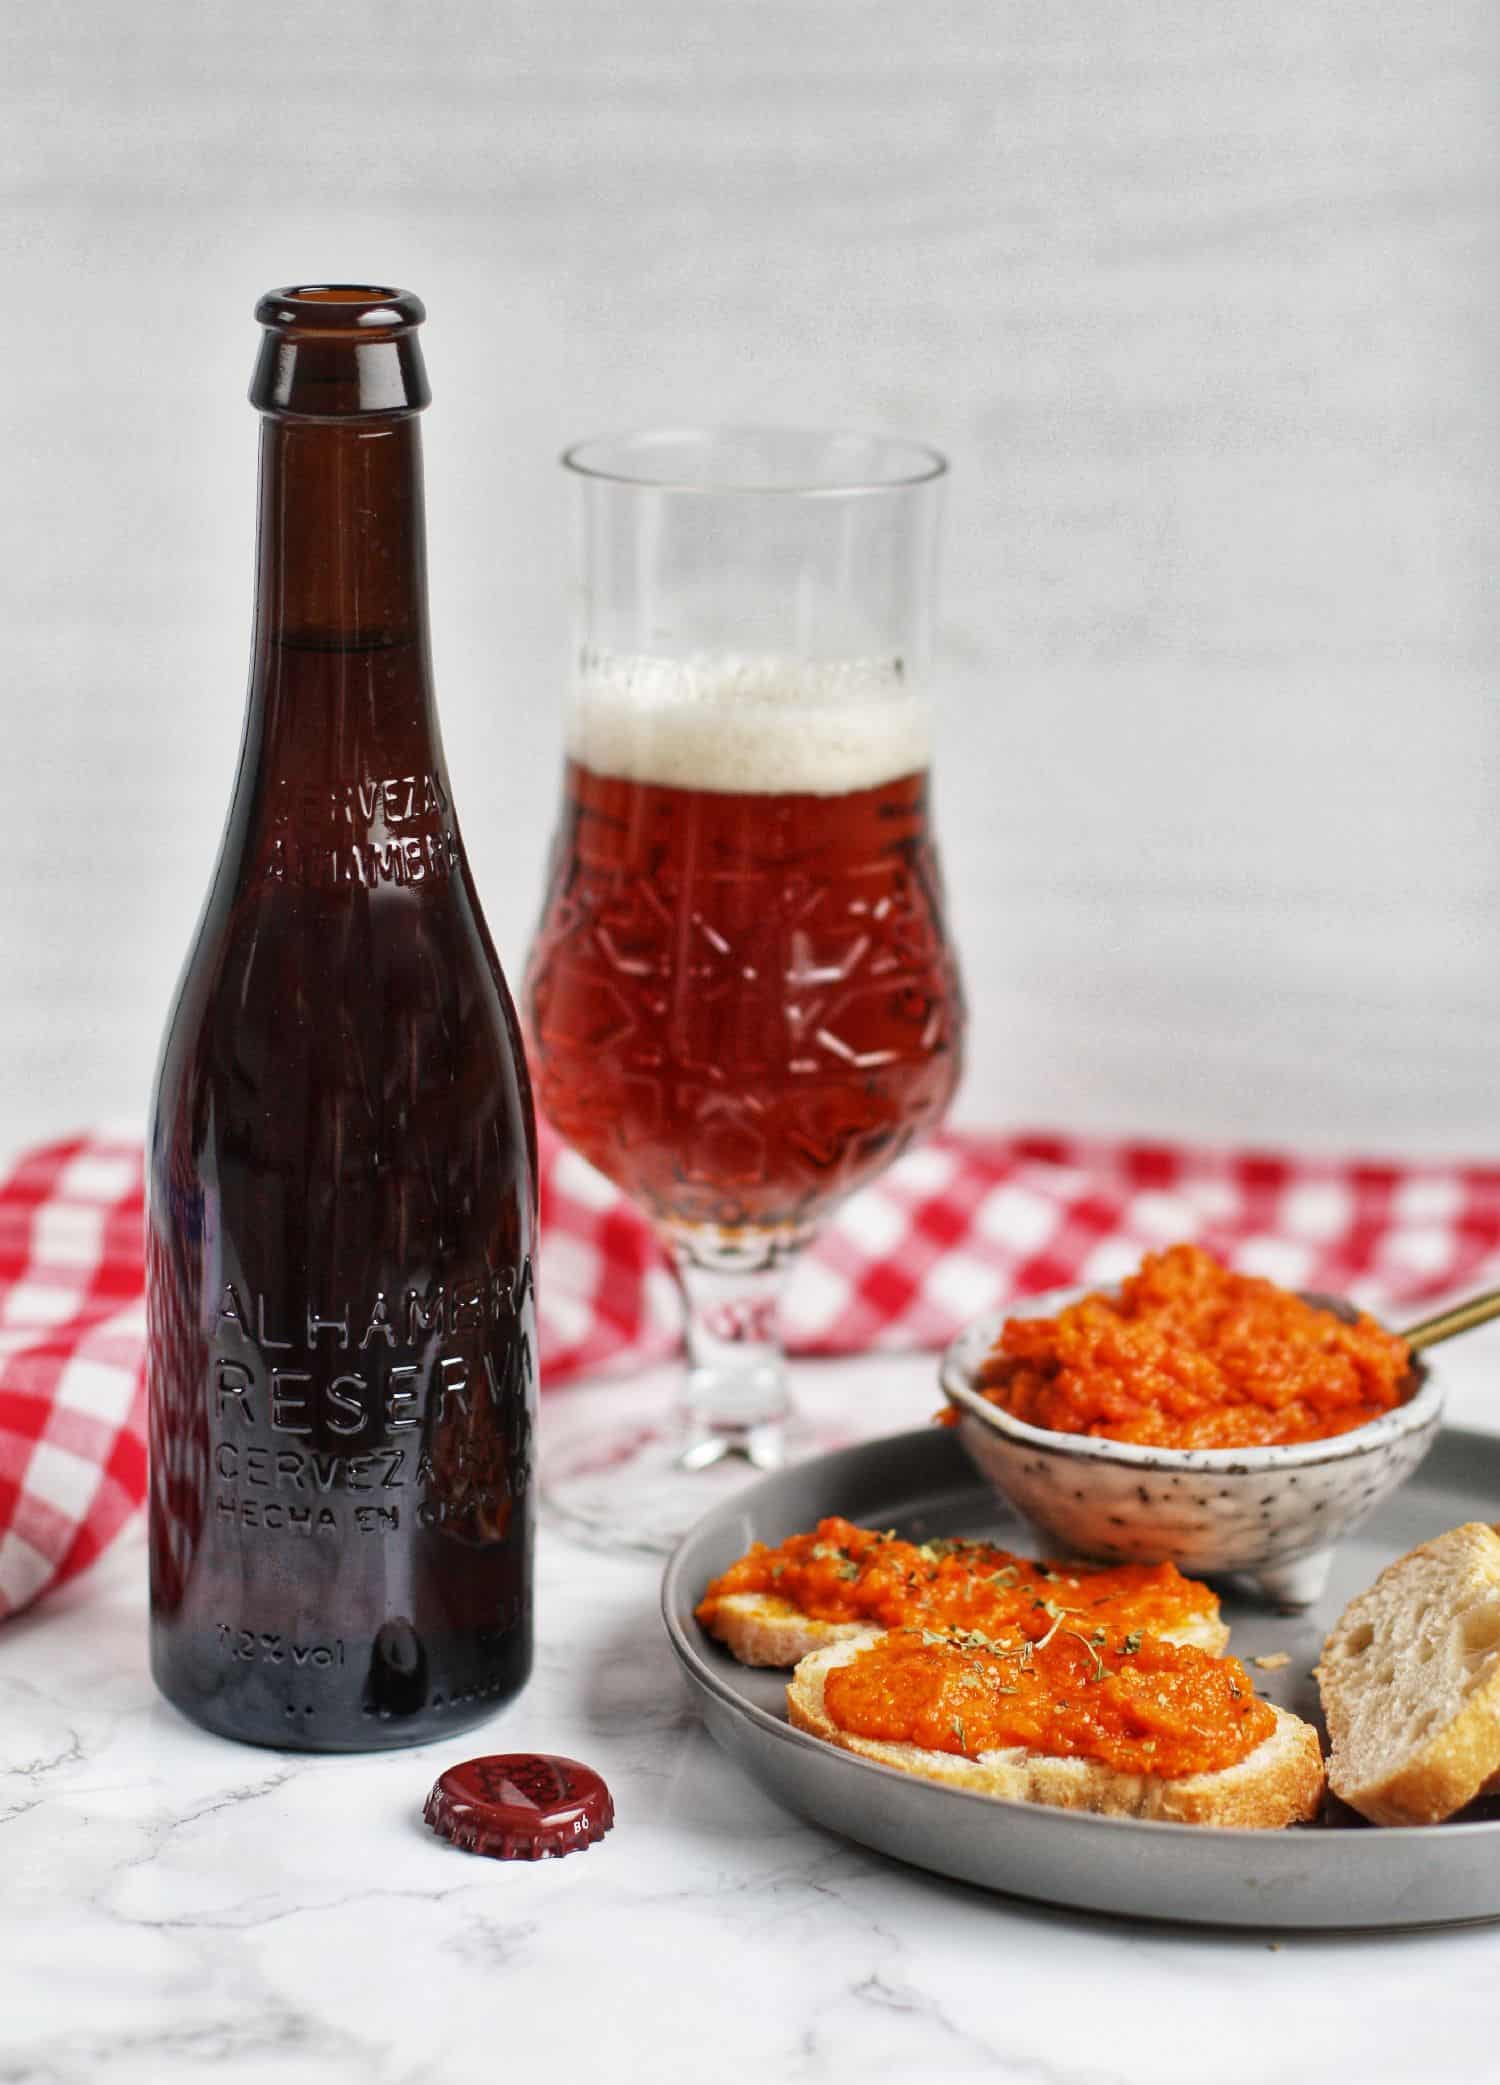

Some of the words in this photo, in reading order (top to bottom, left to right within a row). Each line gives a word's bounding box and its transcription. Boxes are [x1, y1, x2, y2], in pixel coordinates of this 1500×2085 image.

[213, 1257, 535, 1350] ALHAMBRA
[214, 1332, 535, 1435] RESERVA
[214, 1441, 436, 1496] CERVEZA
[214, 1494, 338, 1538] HECHA
[354, 1503, 400, 1534] EN
